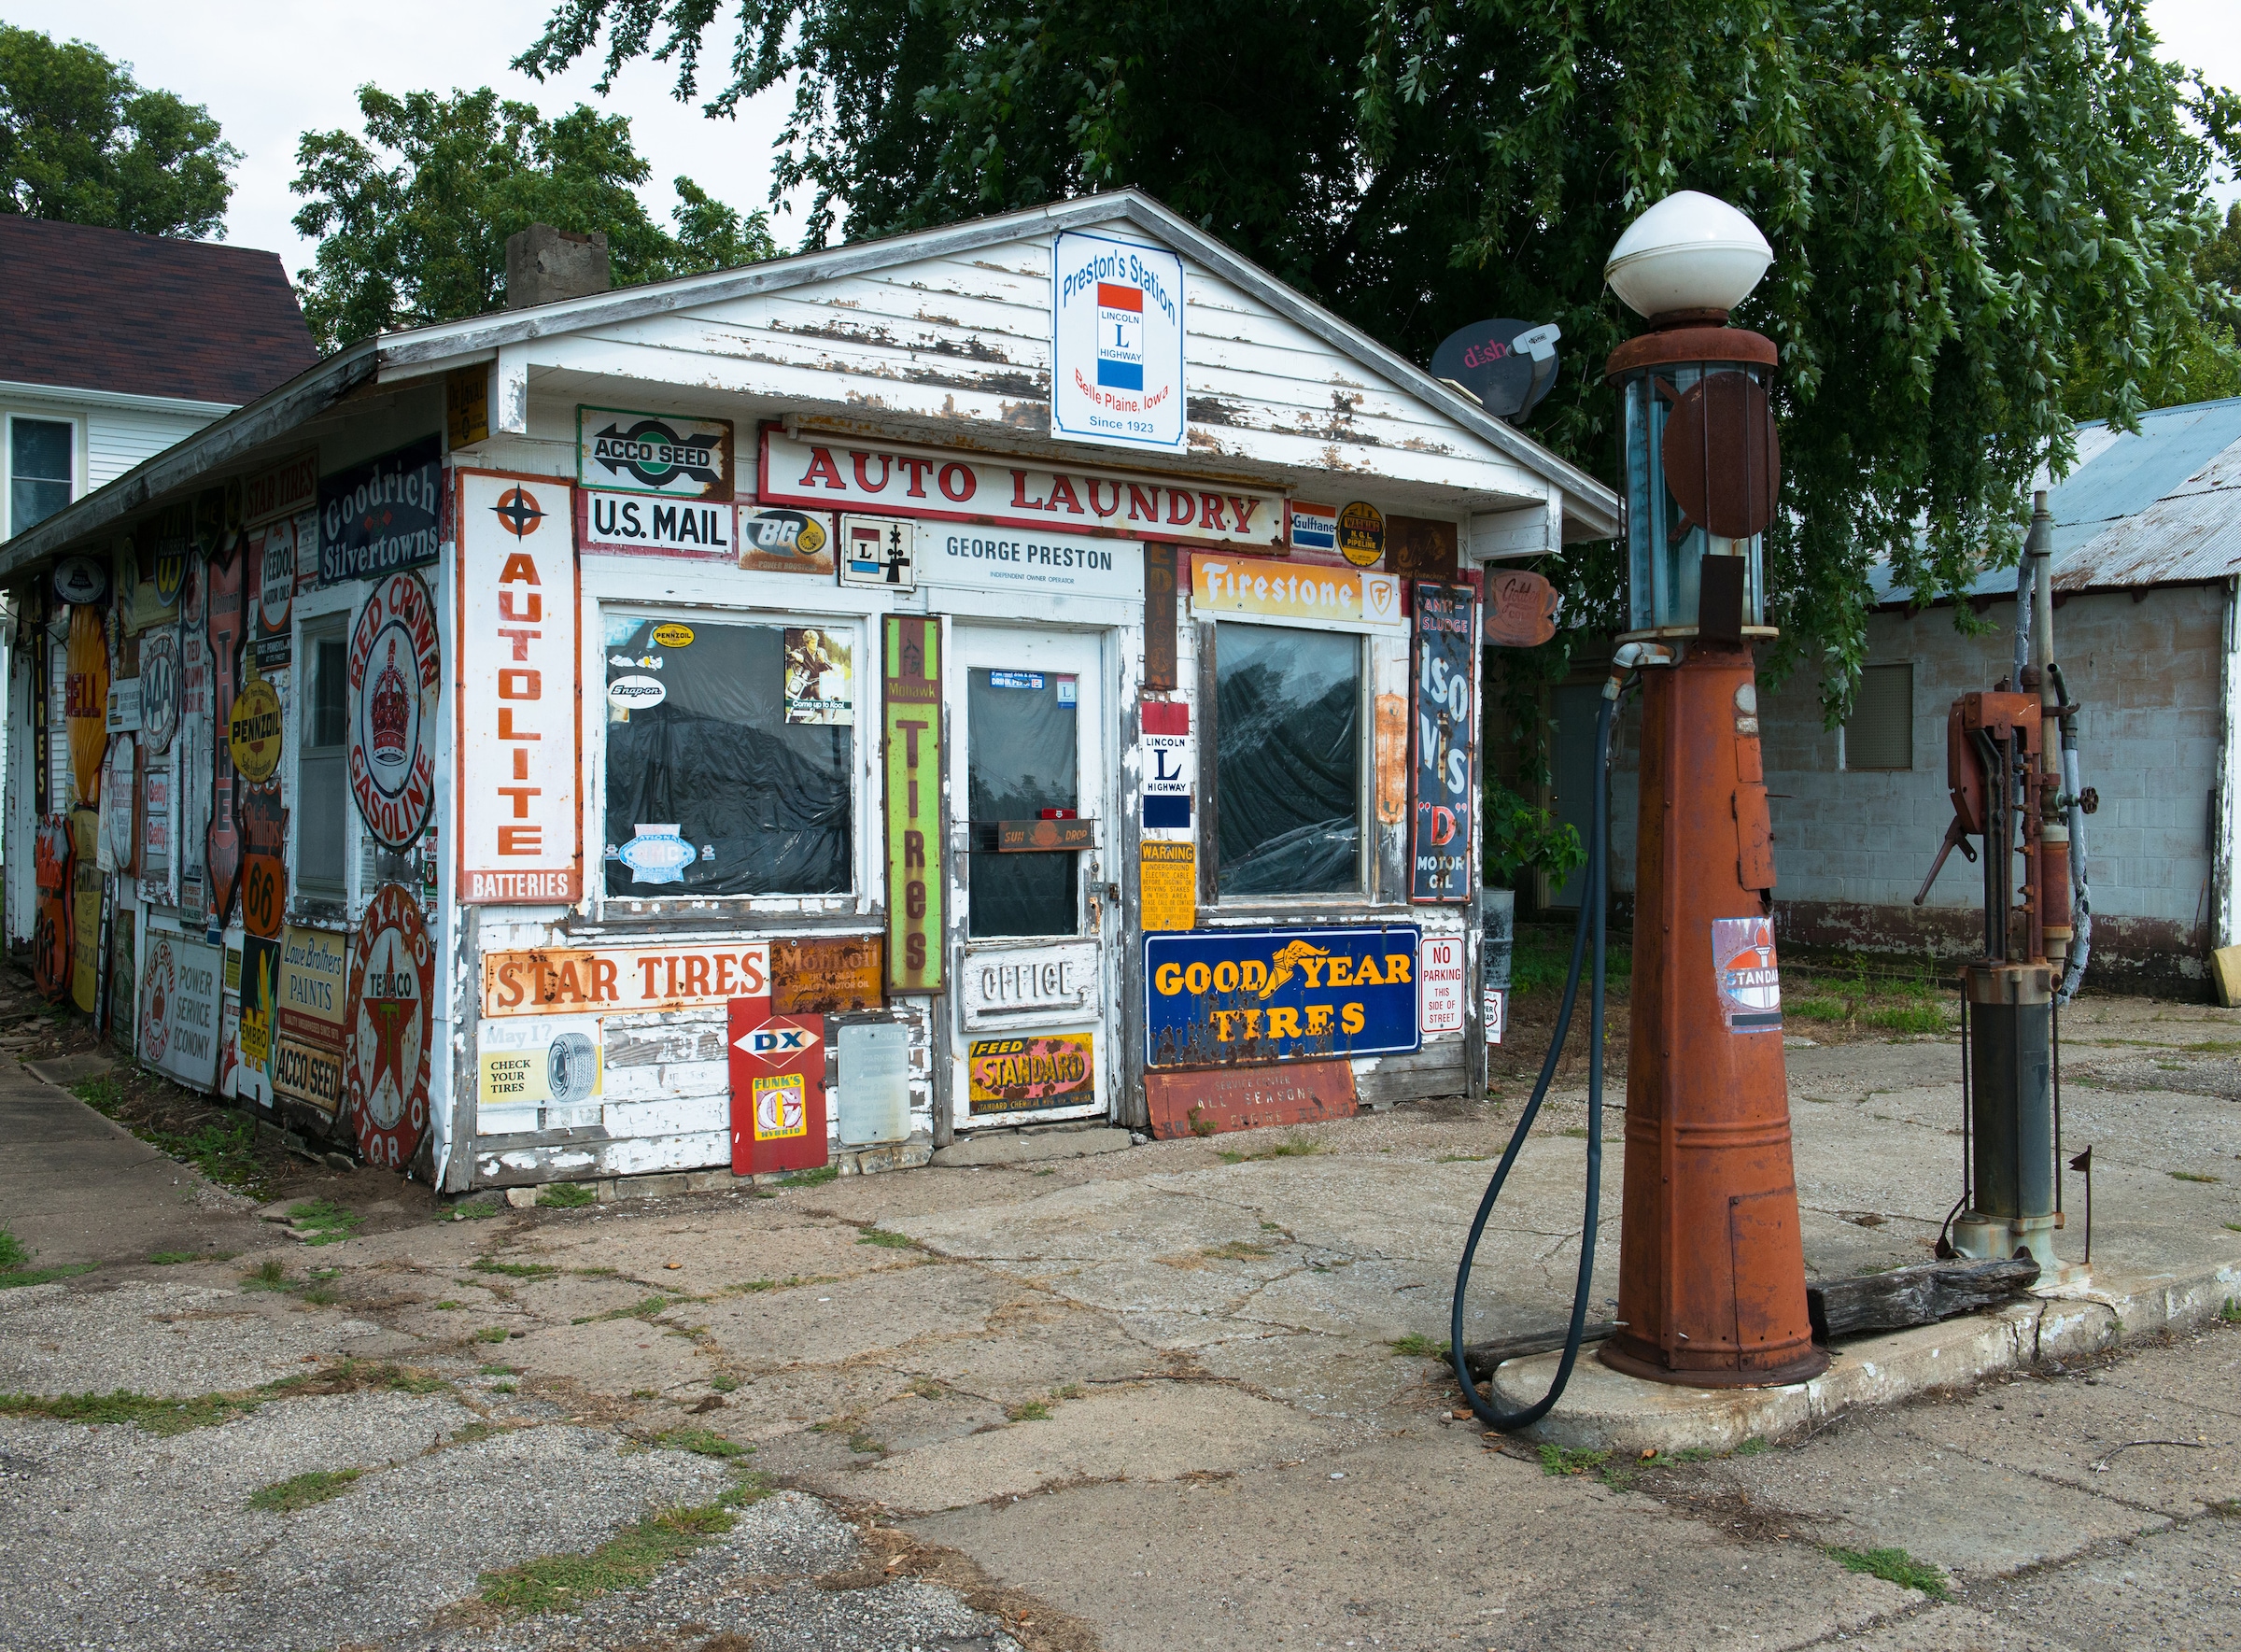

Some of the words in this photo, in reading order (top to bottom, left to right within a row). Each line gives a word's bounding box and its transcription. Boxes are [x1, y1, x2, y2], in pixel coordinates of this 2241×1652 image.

[1064, 249, 1126, 309] Preston's
[1130, 254, 1176, 327] Station
[1101, 310, 1139, 324] LINCOLN
[1115, 323, 1130, 348] L
[1100, 348, 1141, 362] HIGHWAY
[1464, 339, 1506, 369] dish
[1075, 367, 1102, 405] Belle
[1105, 392, 1141, 415] Plaine,
[1144, 384, 1168, 411] Iowa
[1089, 416, 1123, 430] Since
[1126, 420, 1154, 433] 1923
[594, 439, 653, 461] ACCO
[658, 445, 711, 467] SEED
[247, 474, 275, 520] STAR
[278, 456, 315, 506] TIRES
[326, 459, 435, 542] Goodrich
[798, 446, 977, 502] AUTO
[1010, 469, 1261, 535] LAUNDRY
[594, 499, 647, 539] U.S.
[653, 504, 727, 546] MAIL
[754, 520, 801, 547] BG
[1293, 515, 1334, 533] Gulftane
[1346, 516, 1380, 532] WARNING
[158, 537, 186, 556] RUBBER
[324, 526, 438, 580] Silvertowns
[859, 543, 872, 559] L
[946, 536, 1021, 562] GEORGE
[1027, 544, 1112, 571] PRESTON
[1346, 538, 1376, 549] PIPELINE
[263, 545, 293, 587] VEEDOL
[758, 560, 783, 571] POWER
[990, 571, 1024, 580] INDEPENDENT
[1026, 573, 1046, 582] OWNER
[1048, 576, 1074, 585] OPERATOR
[263, 588, 278, 607] MOTOR
[279, 583, 289, 602] OILS
[1202, 562, 1353, 609] Firestone
[210, 587, 240, 616] National
[349, 598, 382, 692] RED
[388, 576, 437, 690] CROWN
[1423, 616, 1468, 642] SLUDGE
[187, 640, 200, 662] RED
[184, 666, 204, 689] CROWN
[992, 678, 1011, 686] DRINK
[1421, 640, 1469, 723] ISO
[65, 671, 101, 718] HELL
[144, 657, 172, 730] AAA
[497, 552, 542, 856] AUTOLITE
[612, 685, 662, 698] Snap-on
[888, 683, 937, 699] Mohawk
[1063, 686, 1071, 698] L
[35, 633, 45, 795] TIRES
[792, 700, 813, 709] Come
[814, 701, 823, 711] up
[824, 700, 829, 709] to
[232, 711, 280, 745] PENNZOIL
[1147, 738, 1185, 747] LINCOLN
[1420, 713, 1467, 794] VIS
[1153, 749, 1182, 781] L
[149, 779, 166, 808] Getty
[350, 743, 433, 844] GASOLINE
[1148, 782, 1186, 793] HIGHWAY
[148, 821, 166, 851] Getty
[244, 801, 280, 856] Phillips
[1004, 830, 1025, 843] SUN
[1065, 828, 1088, 841] DROP
[1142, 844, 1192, 860] WARNING
[1417, 854, 1464, 870] MOTOR
[472, 872, 569, 897] BATTERIES
[1430, 875, 1453, 889] OIL
[248, 862, 274, 929] 66
[353, 888, 429, 971] TEXACO
[284, 934, 305, 969] Lowe
[305, 937, 342, 976] Brothers
[1433, 946, 1450, 964] NO
[148, 952, 158, 989] RED
[160, 943, 175, 994] CROWN
[179, 966, 213, 996] POWER
[498, 963, 620, 1009] STAR
[638, 952, 763, 1000] TIRES
[982, 962, 1074, 1001] OFFICE
[1155, 960, 1268, 996] GOOD
[1298, 953, 1412, 989] YEAR
[1424, 968, 1460, 981] PARKING
[290, 974, 331, 1011] PAINTS
[370, 972, 412, 997] TEXACO
[827, 981, 856, 991] MOTOR
[857, 980, 870, 989] OIL
[1434, 987, 1450, 997] THIS
[176, 995, 211, 1029] SERVICE
[1429, 1001, 1444, 1011] SIDE
[1446, 1000, 1456, 1010] OF
[144, 1010, 170, 1059] GASOLINE
[243, 1021, 267, 1049] EMBRO
[379, 1003, 400, 1065] T
[1210, 1003, 1366, 1043] TIRES
[174, 1027, 210, 1061] ECONOMY
[486, 1027, 527, 1049] May
[530, 1024, 553, 1042] I?
[754, 1030, 805, 1052] DX
[976, 1040, 1023, 1055] FEED
[490, 1059, 531, 1071] CHECK
[863, 1053, 901, 1064] PARKING
[982, 1052, 1086, 1091] STANDARD
[276, 1047, 307, 1091] ACCO
[310, 1057, 337, 1101] SEED
[491, 1070, 526, 1082] YOUR
[754, 1074, 801, 1090] FUNK'S
[1216, 1078, 1252, 1091] SERVICE
[345, 1033, 400, 1167] MOTOR
[411, 1048, 431, 1132] OIL
[490, 1081, 525, 1094] TIRES
[978, 1102, 1008, 1113] TANDARD
[1010, 1096, 1039, 1109] CHEMICAL
[1197, 1094, 1228, 1109] ALL
[1229, 1110, 1282, 1127] ENGINE
[761, 1126, 801, 1138] HYBRID
